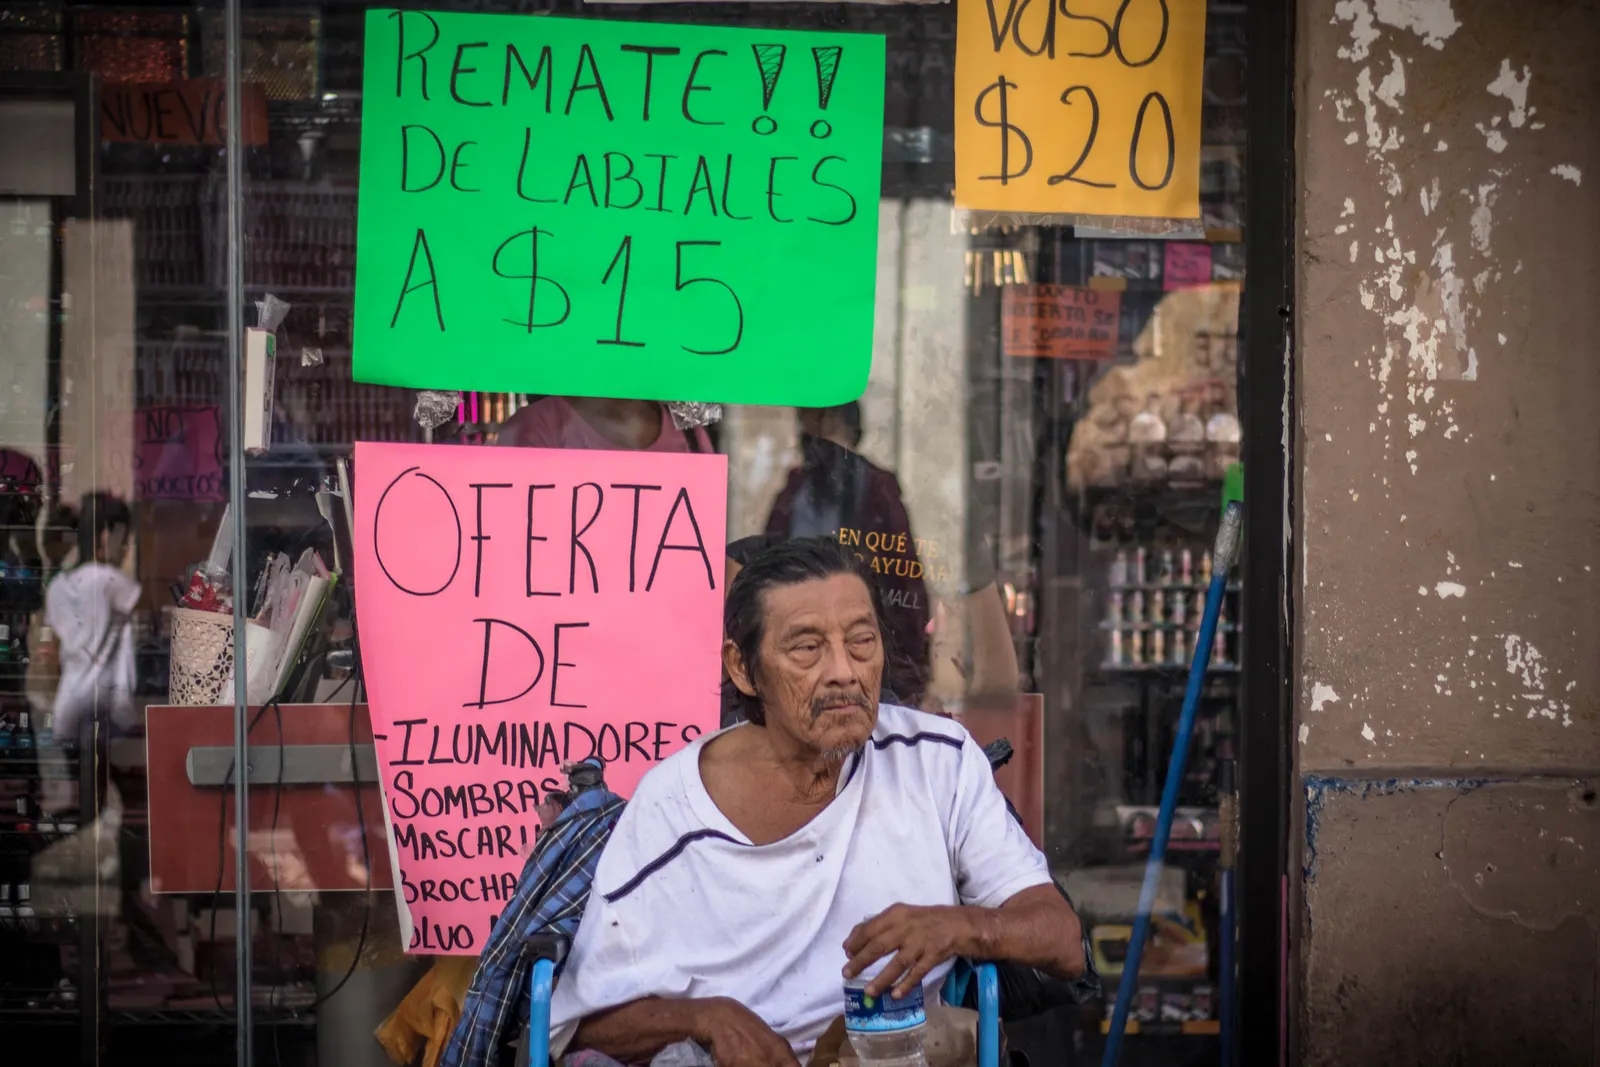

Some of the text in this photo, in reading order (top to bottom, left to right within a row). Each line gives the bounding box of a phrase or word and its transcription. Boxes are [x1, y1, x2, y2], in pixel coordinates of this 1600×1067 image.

[401, 125, 857, 225] DE LABIALES
[974, 75, 1175, 190] $20
[390, 225, 743, 355] A $15
[146, 411, 184, 438] NO
[374, 466, 715, 597] OFERTA
[865, 531, 907, 553] QUÉ
[914, 538, 939, 558] TE
[462, 618, 589, 709] DE
[395, 824, 541, 860] MASCARI
